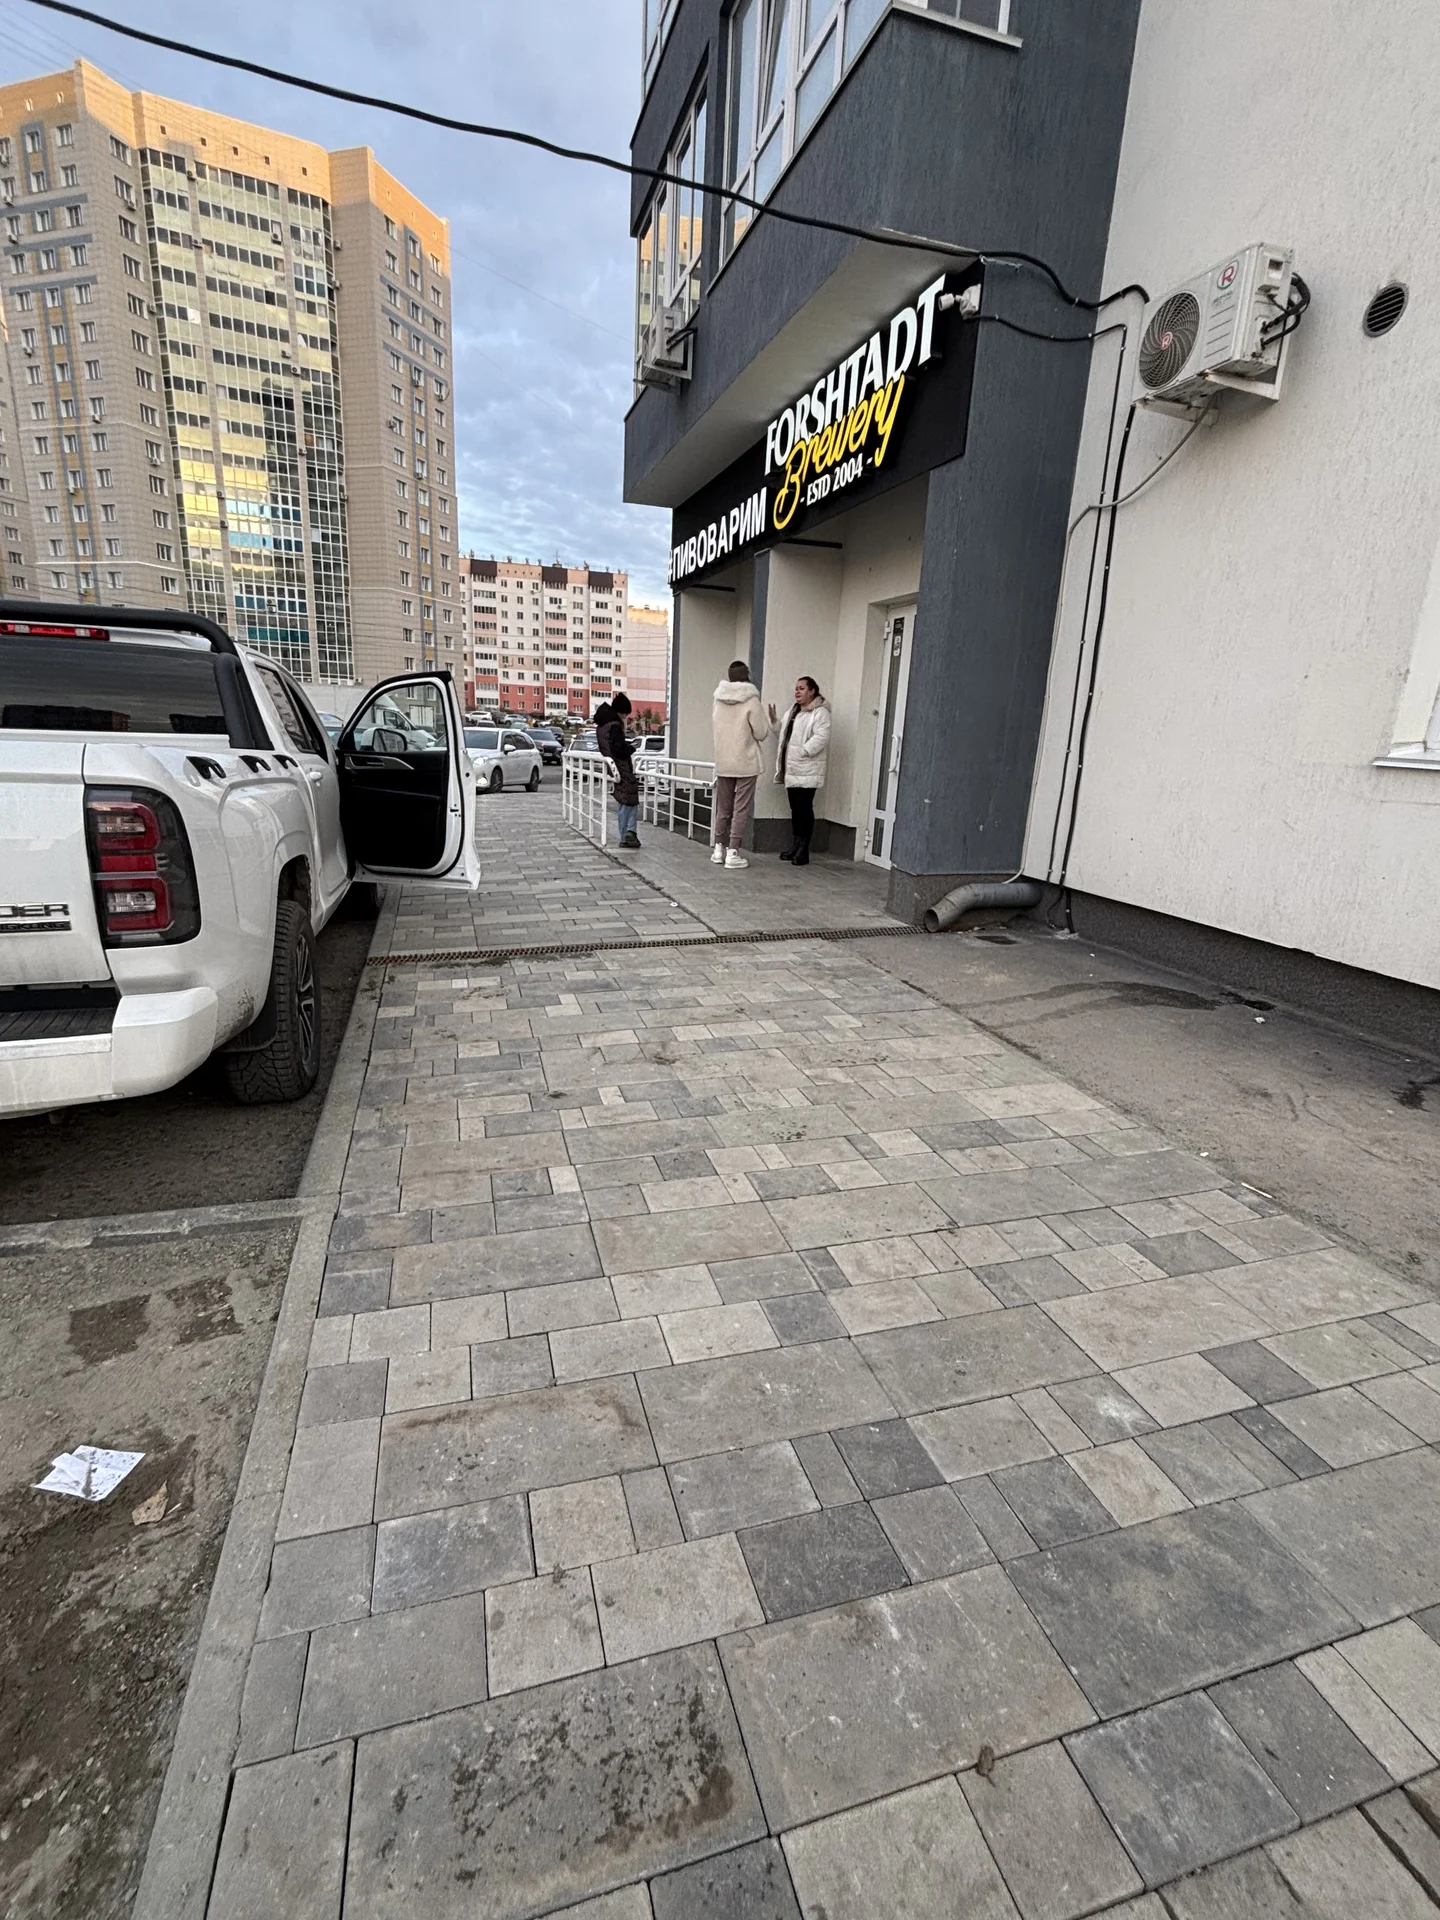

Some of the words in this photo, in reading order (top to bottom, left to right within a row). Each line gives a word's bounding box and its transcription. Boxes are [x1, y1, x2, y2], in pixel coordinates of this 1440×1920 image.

[765, 273, 946, 476] FORSHTADT
[773, 374, 905, 529] Brewery
[806, 476, 831, 507] ESTD
[833, 453, 863, 492] 2004
